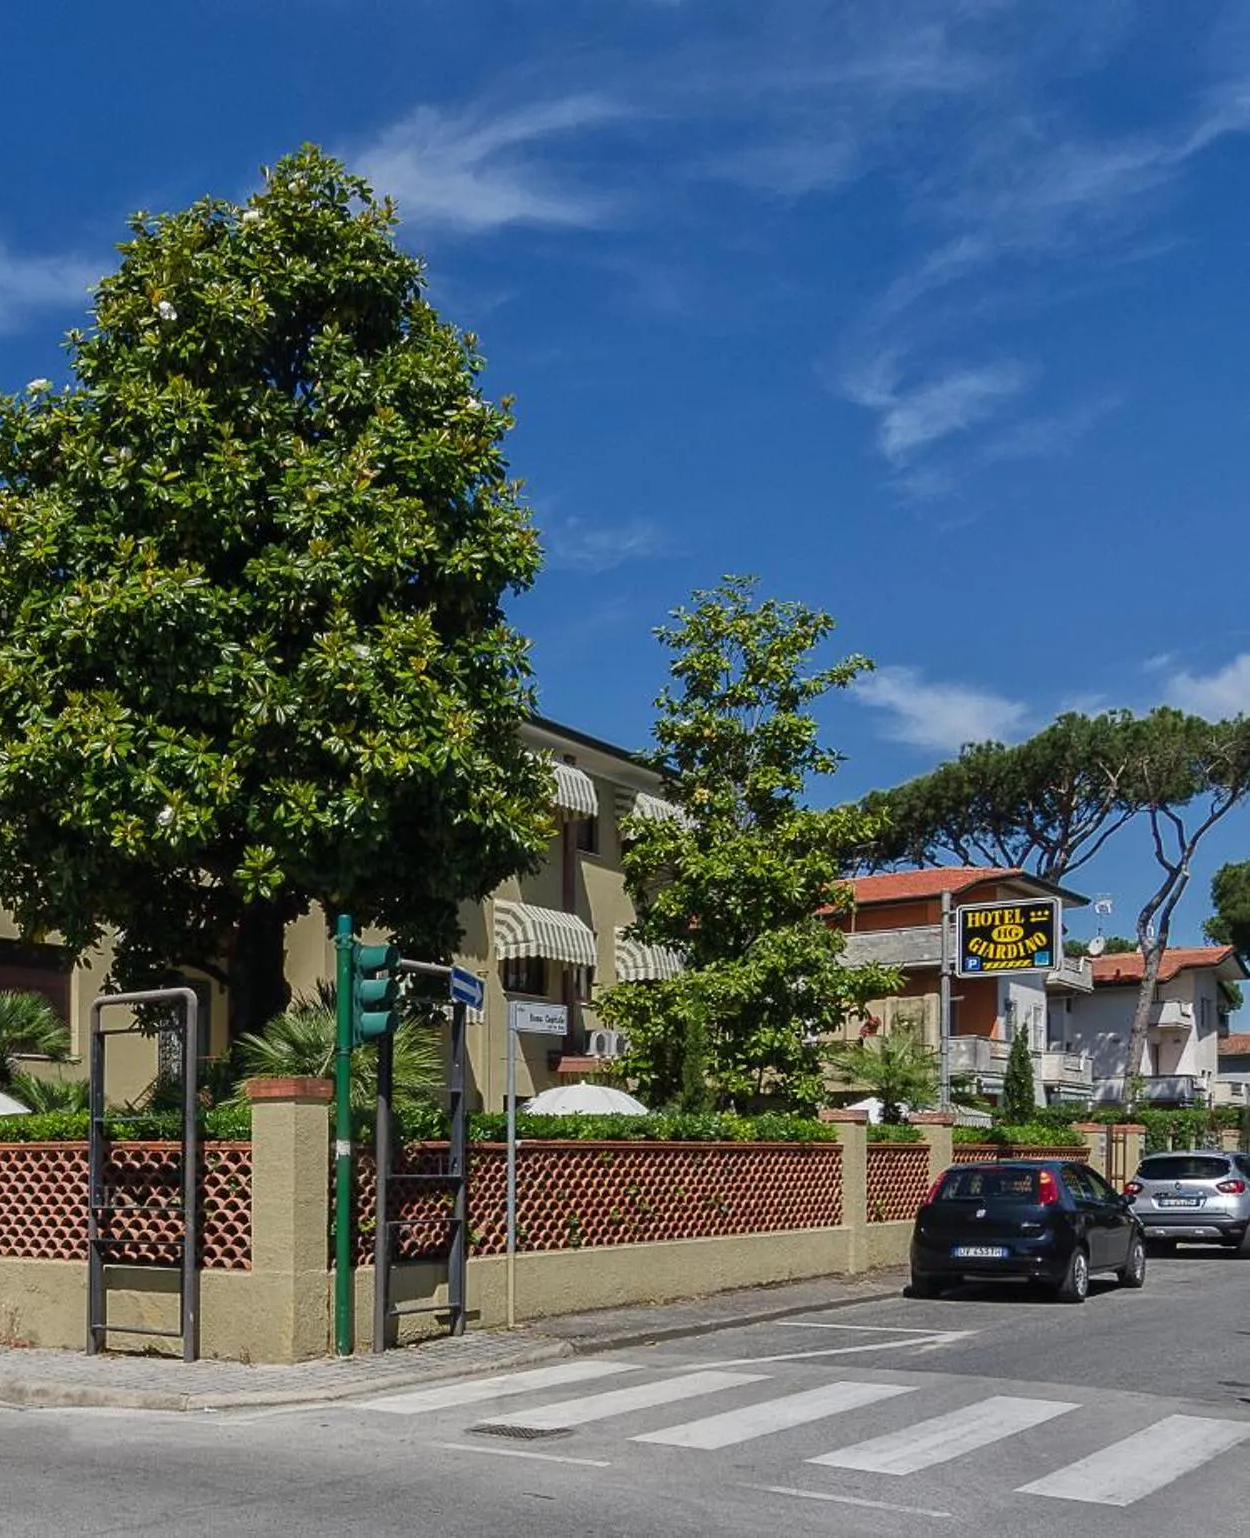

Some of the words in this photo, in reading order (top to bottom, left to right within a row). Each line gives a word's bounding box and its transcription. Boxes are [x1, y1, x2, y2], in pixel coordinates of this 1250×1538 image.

[966, 908, 1025, 928] HOTEL
[997, 927, 1019, 939] HG
[967, 931, 1048, 959] GIARDINO
